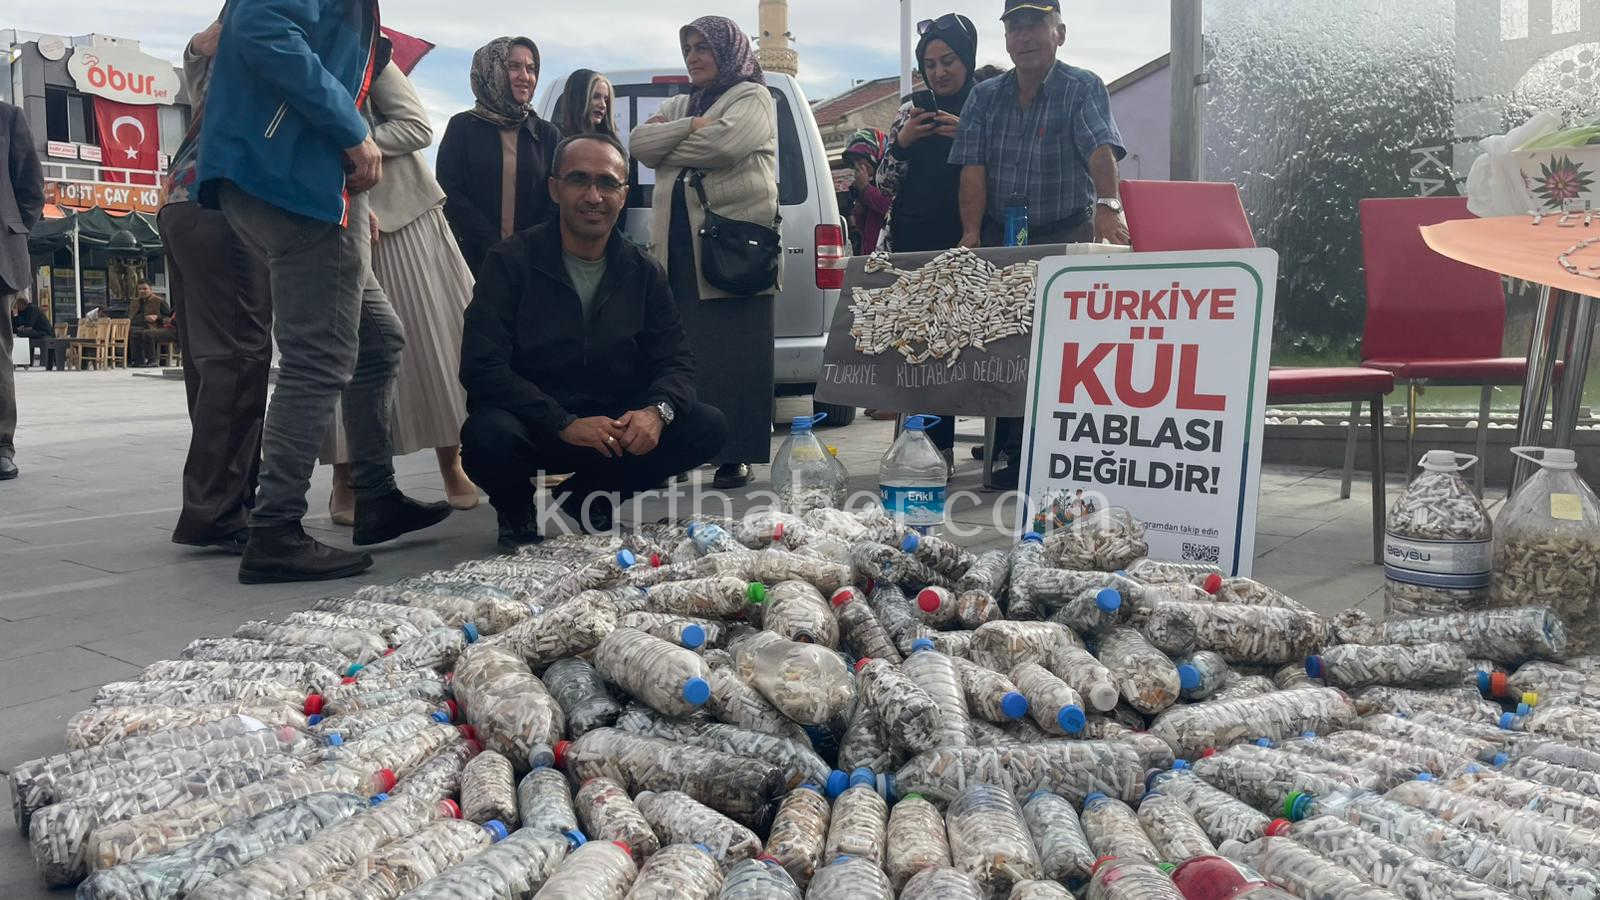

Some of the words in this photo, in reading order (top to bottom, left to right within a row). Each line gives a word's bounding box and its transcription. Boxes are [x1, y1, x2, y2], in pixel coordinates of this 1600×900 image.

[88, 64, 155, 96] obur
[104, 188, 130, 206] ÇAY
[1063, 281, 1237, 321] TÜRKİYE
[1058, 326, 1227, 412] KÜL
[1053, 411, 1223, 453] TABLASI
[1201, 528, 1219, 536] edin
